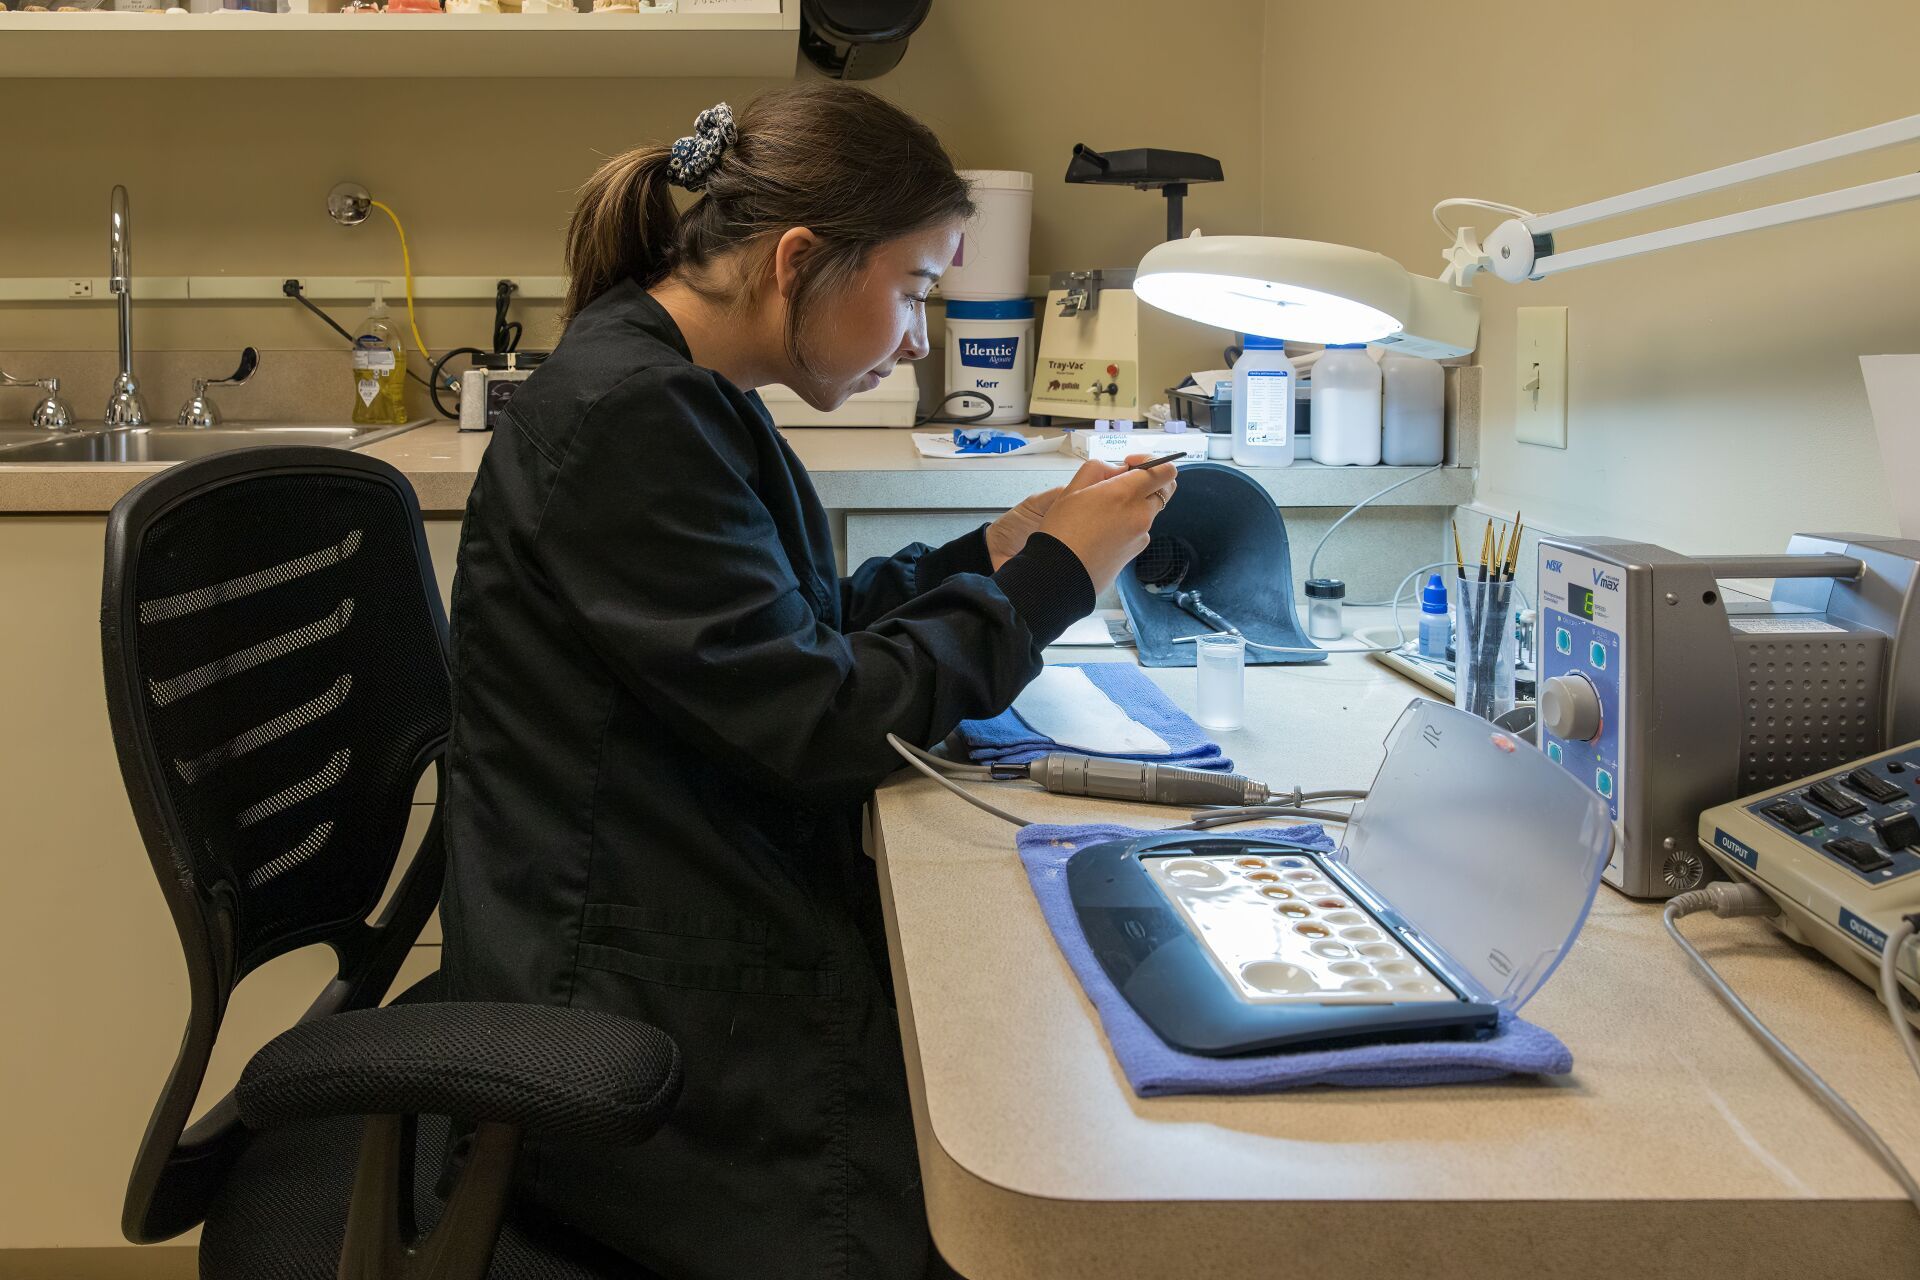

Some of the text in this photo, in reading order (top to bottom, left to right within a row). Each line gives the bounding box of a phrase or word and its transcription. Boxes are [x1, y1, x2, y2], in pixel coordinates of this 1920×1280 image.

[965, 343, 1012, 356] Identic
[1049, 361, 1084, 371] Tray-Vac
[976, 379, 999, 388] Kerr
[1546, 559, 1563, 573] NSK
[1722, 836, 1749, 860] OUTPUT
[1849, 918, 1885, 948] OUTPUT
